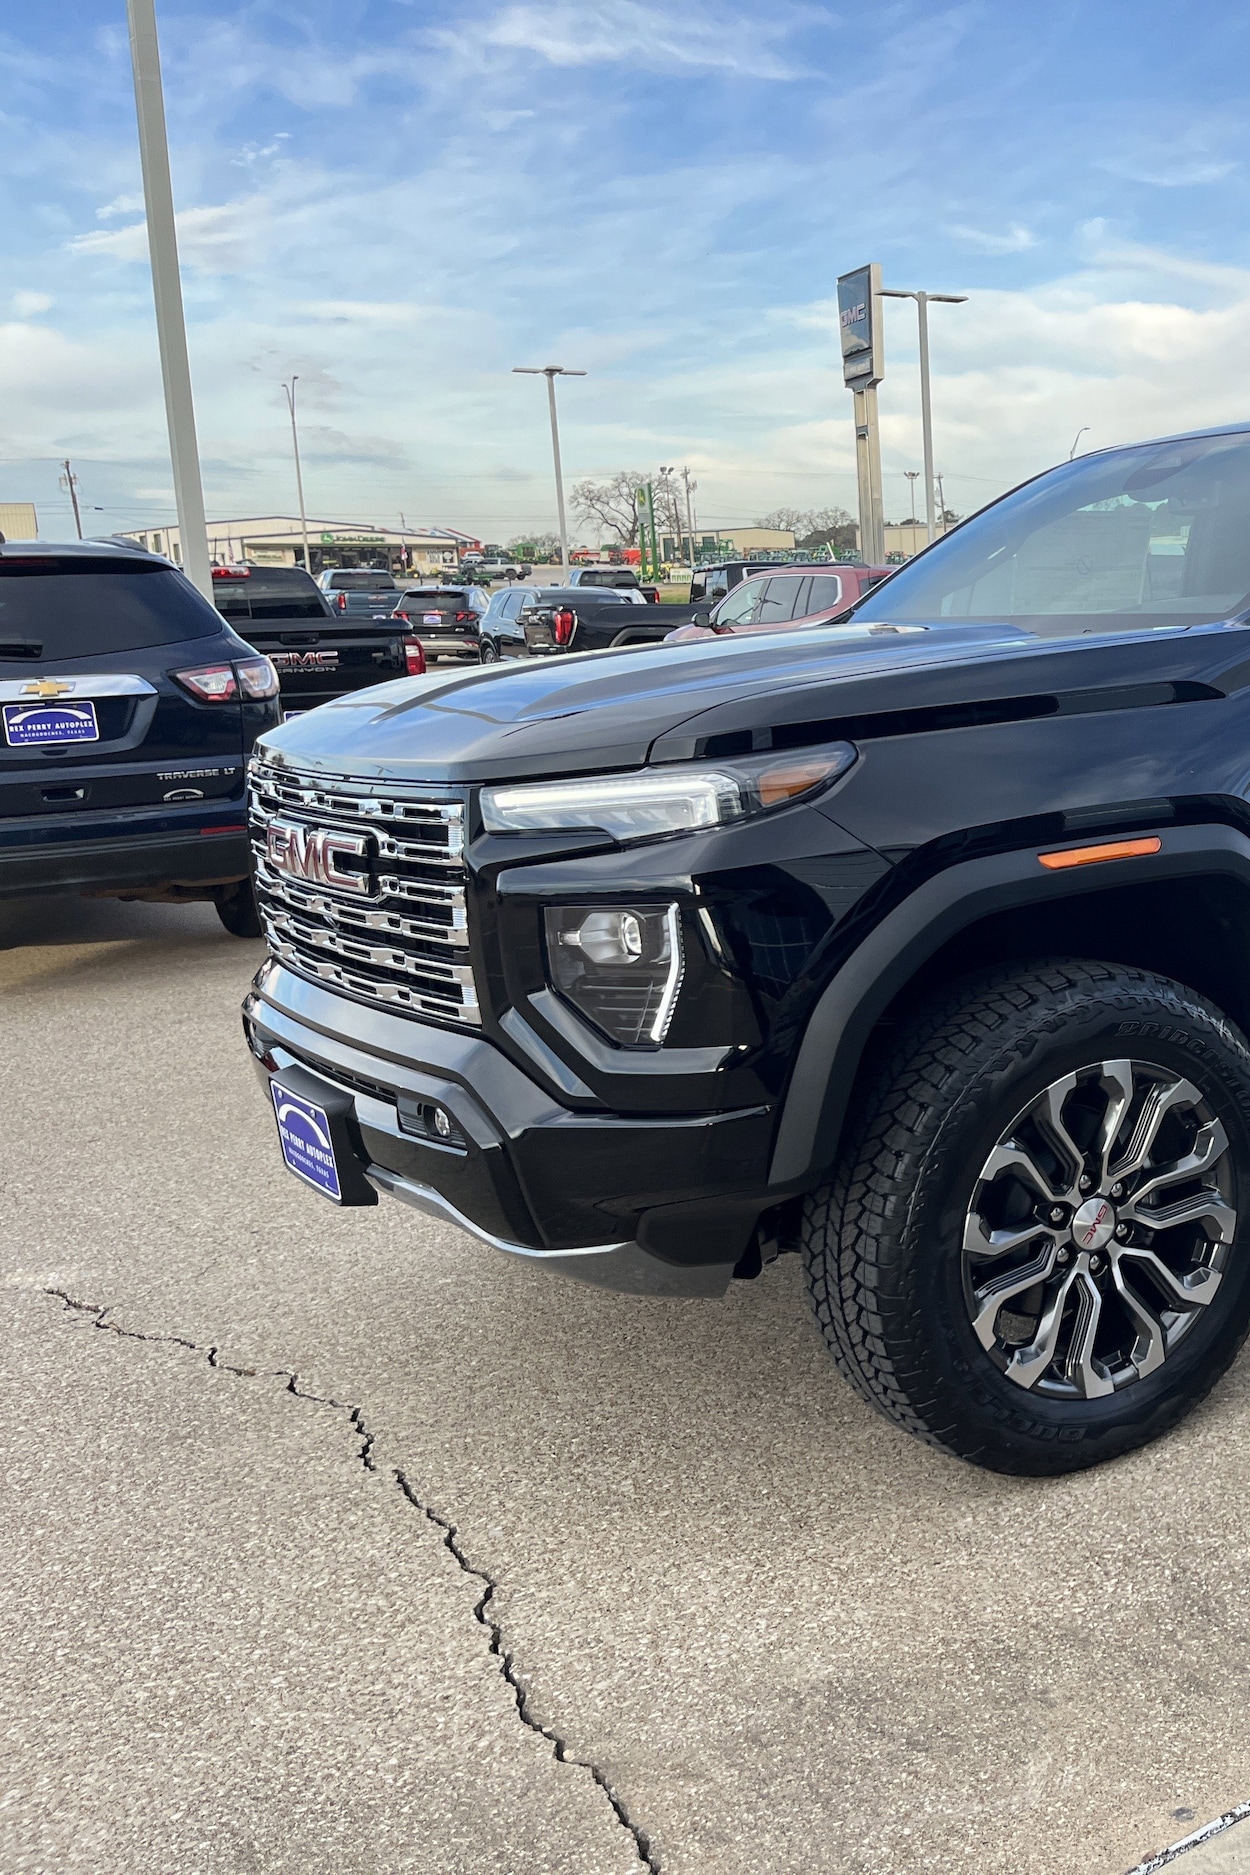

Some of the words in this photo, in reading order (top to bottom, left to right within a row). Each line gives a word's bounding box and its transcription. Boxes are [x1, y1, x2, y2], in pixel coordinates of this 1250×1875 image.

[840, 302, 866, 328] GMC
[267, 650, 340, 667] GMC
[9, 724, 25, 733] REX
[27, 722, 52, 732] PERRY
[54, 720, 94, 730] AUTOPLEX
[156, 768, 220, 780] TRAVERSE
[223, 767, 236, 775] LT
[267, 820, 370, 895] GMC
[289, 1132, 306, 1152] PERRY
[305, 1142, 334, 1169] AUTOPLEX
[1080, 1203, 1109, 1246] GMC
